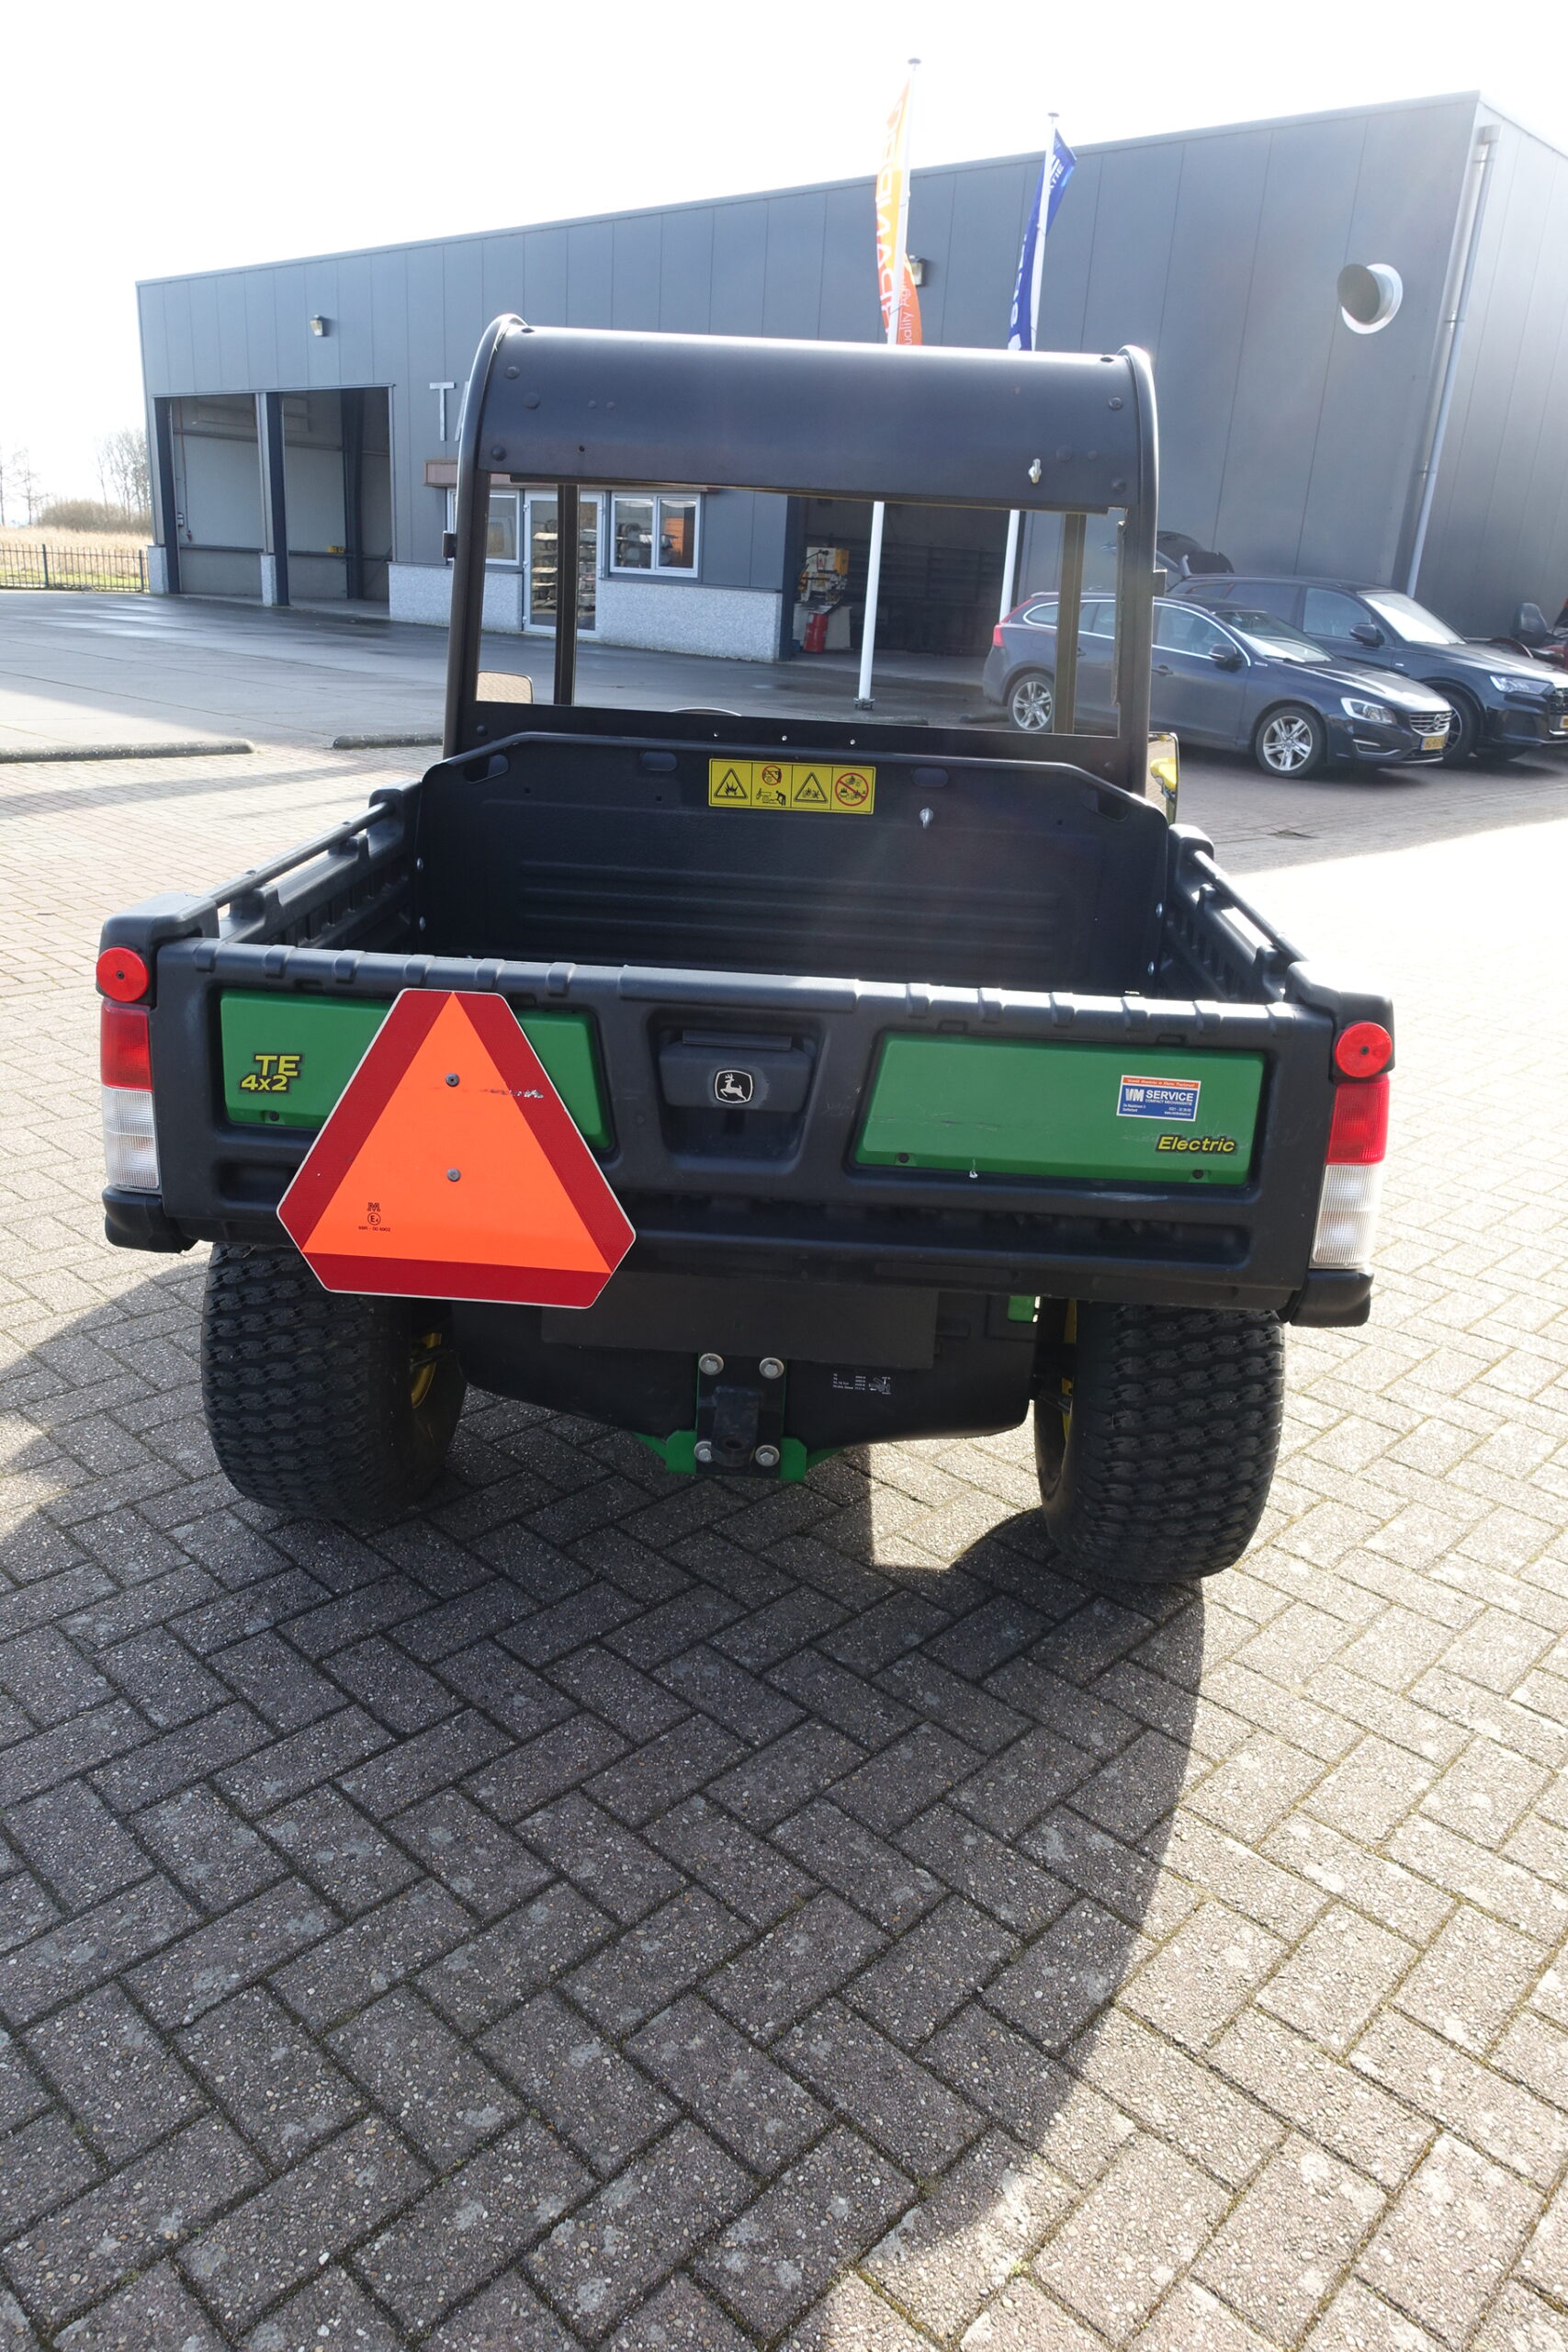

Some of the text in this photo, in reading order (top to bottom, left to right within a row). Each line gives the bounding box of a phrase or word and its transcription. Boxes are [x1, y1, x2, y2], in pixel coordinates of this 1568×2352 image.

[254, 1055, 300, 1077] TE
[240, 1074, 288, 1091] 4x2
[1145, 1090, 1194, 1102] SERVICE
[1156, 1136, 1236, 1153] Electric
